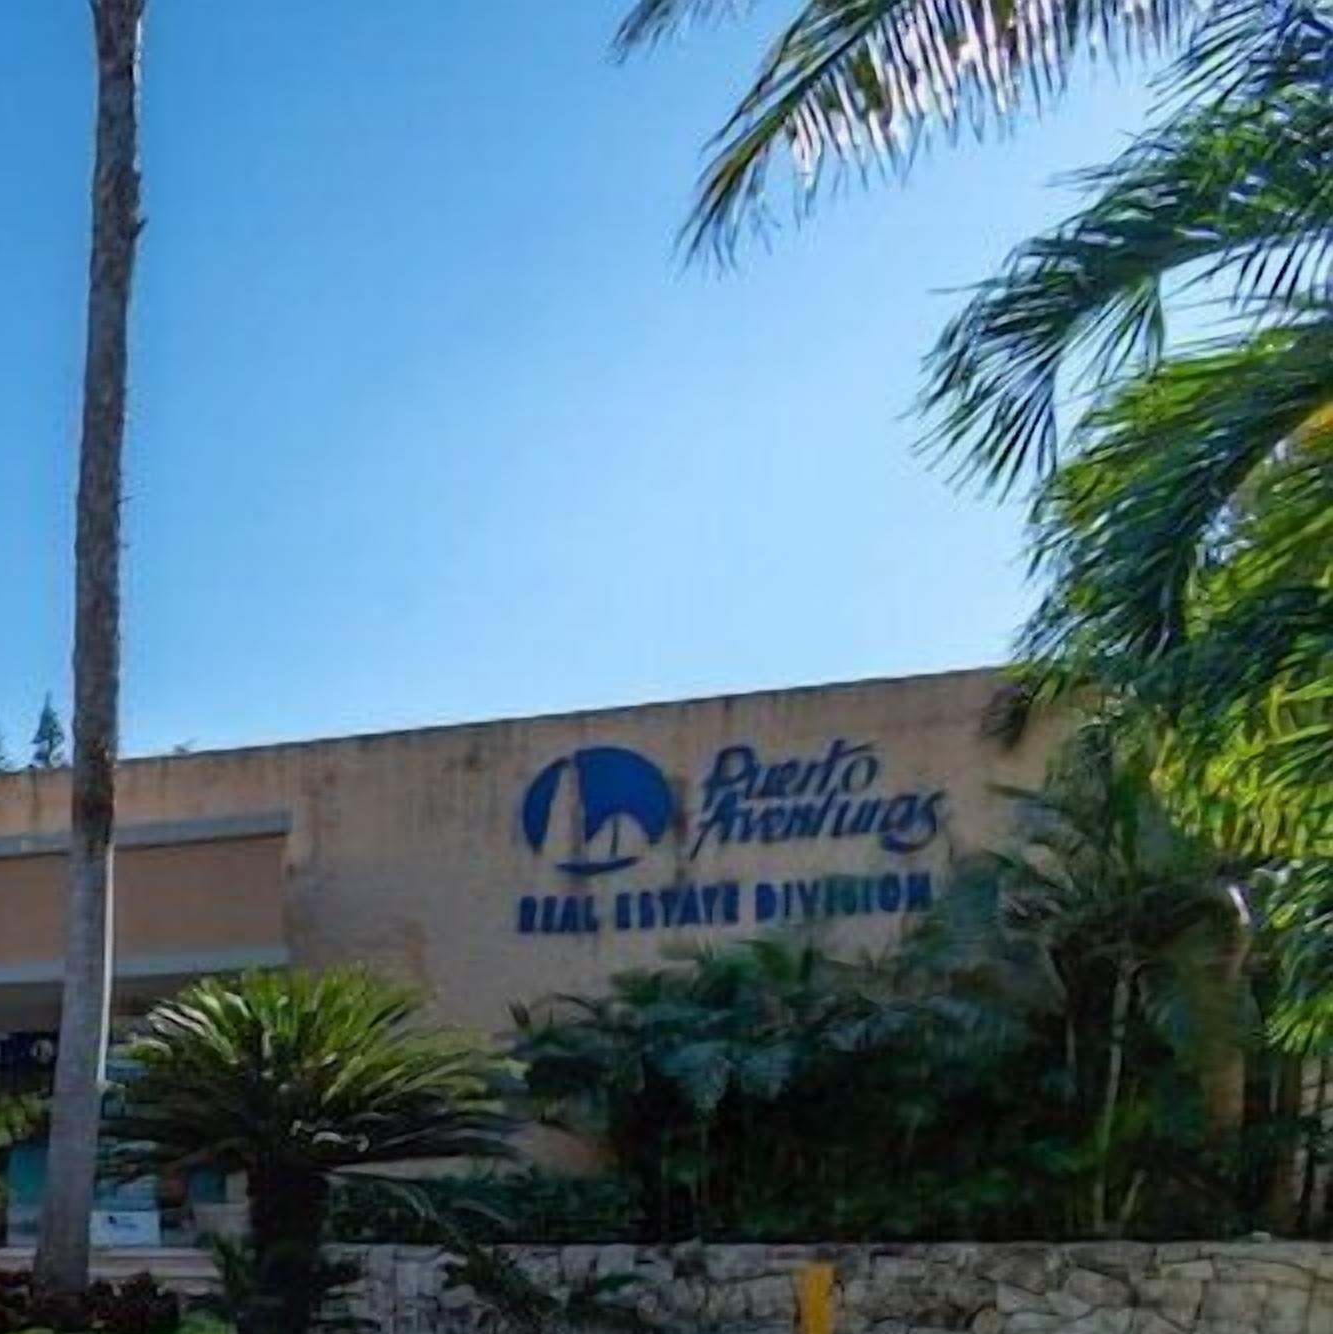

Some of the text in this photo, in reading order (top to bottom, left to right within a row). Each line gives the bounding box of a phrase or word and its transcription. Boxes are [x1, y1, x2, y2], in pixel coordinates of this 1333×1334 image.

[701, 739, 881, 811] Puerto
[689, 786, 950, 862] Aventuras
[518, 872, 932, 934] REAL ESTATE DIVISION
